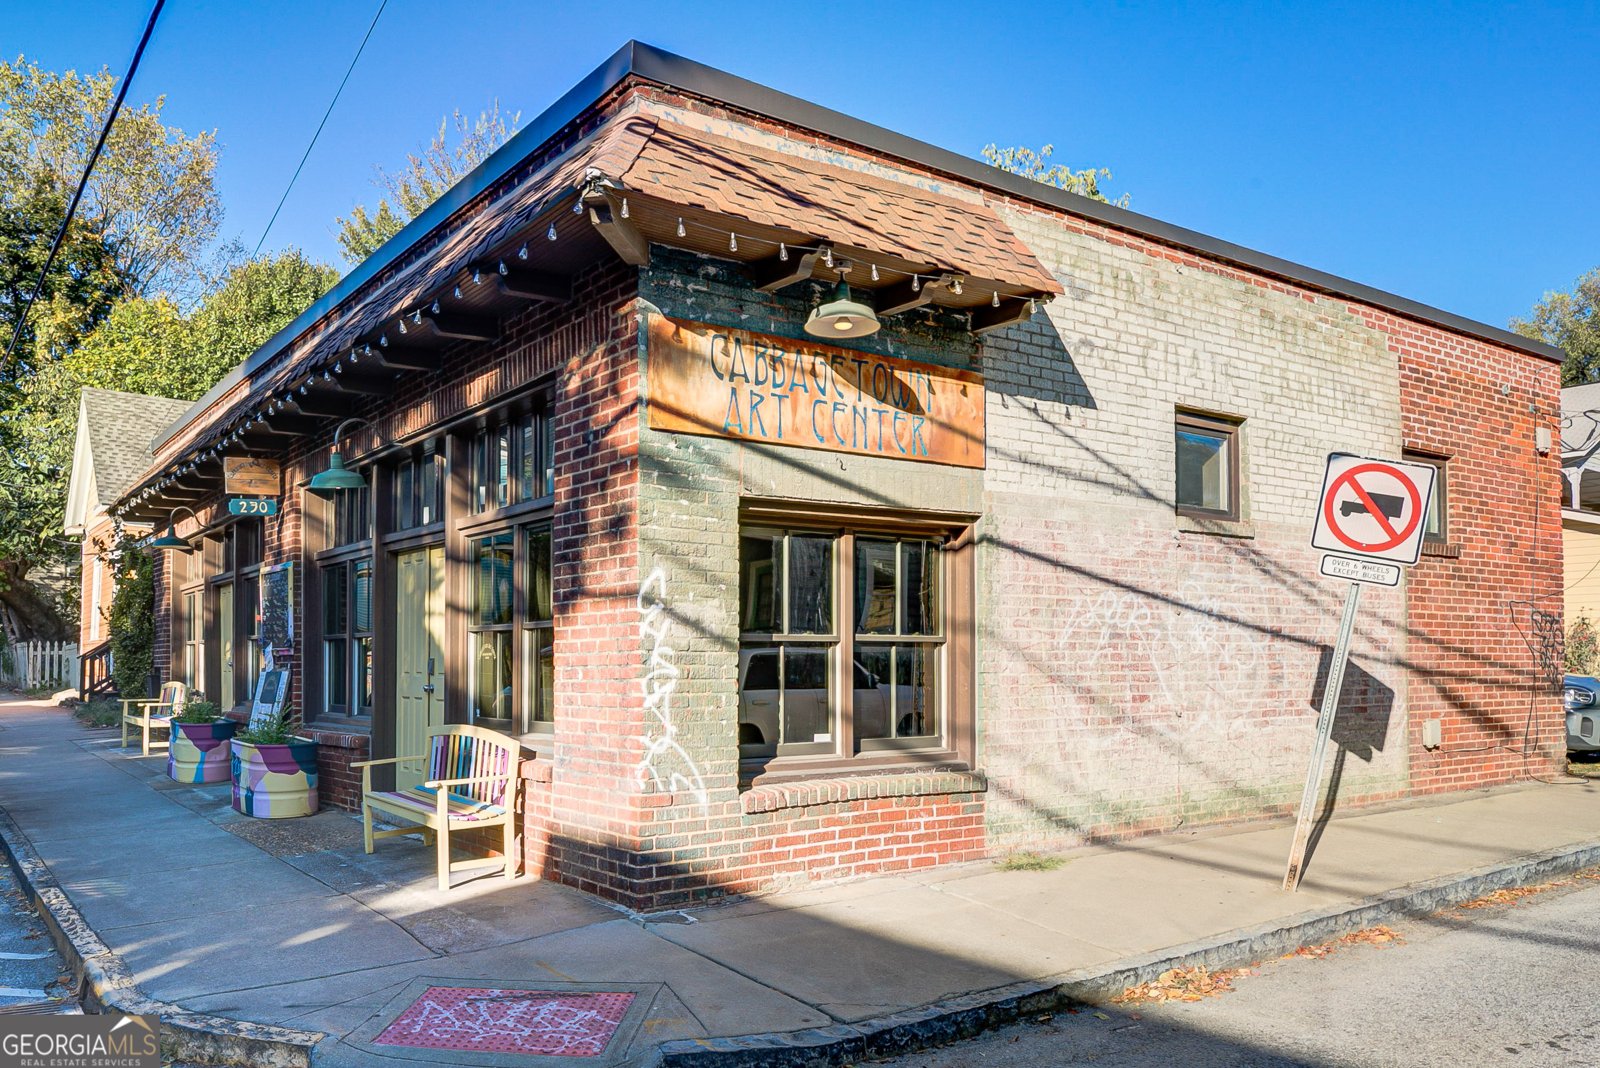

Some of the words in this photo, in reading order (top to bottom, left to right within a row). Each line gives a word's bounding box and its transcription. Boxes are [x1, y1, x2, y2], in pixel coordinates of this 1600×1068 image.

[722, 386, 791, 439] ART
[811, 398, 929, 457] CENTER
[239, 501, 268, 513] 230
[1332, 559, 1351, 569] OVER
[1353, 562, 1358, 570] 6
[1362, 564, 1390, 574] WHEELS
[1333, 567, 1359, 577] EXCEPT
[1362, 572, 1386, 581] BUSES
